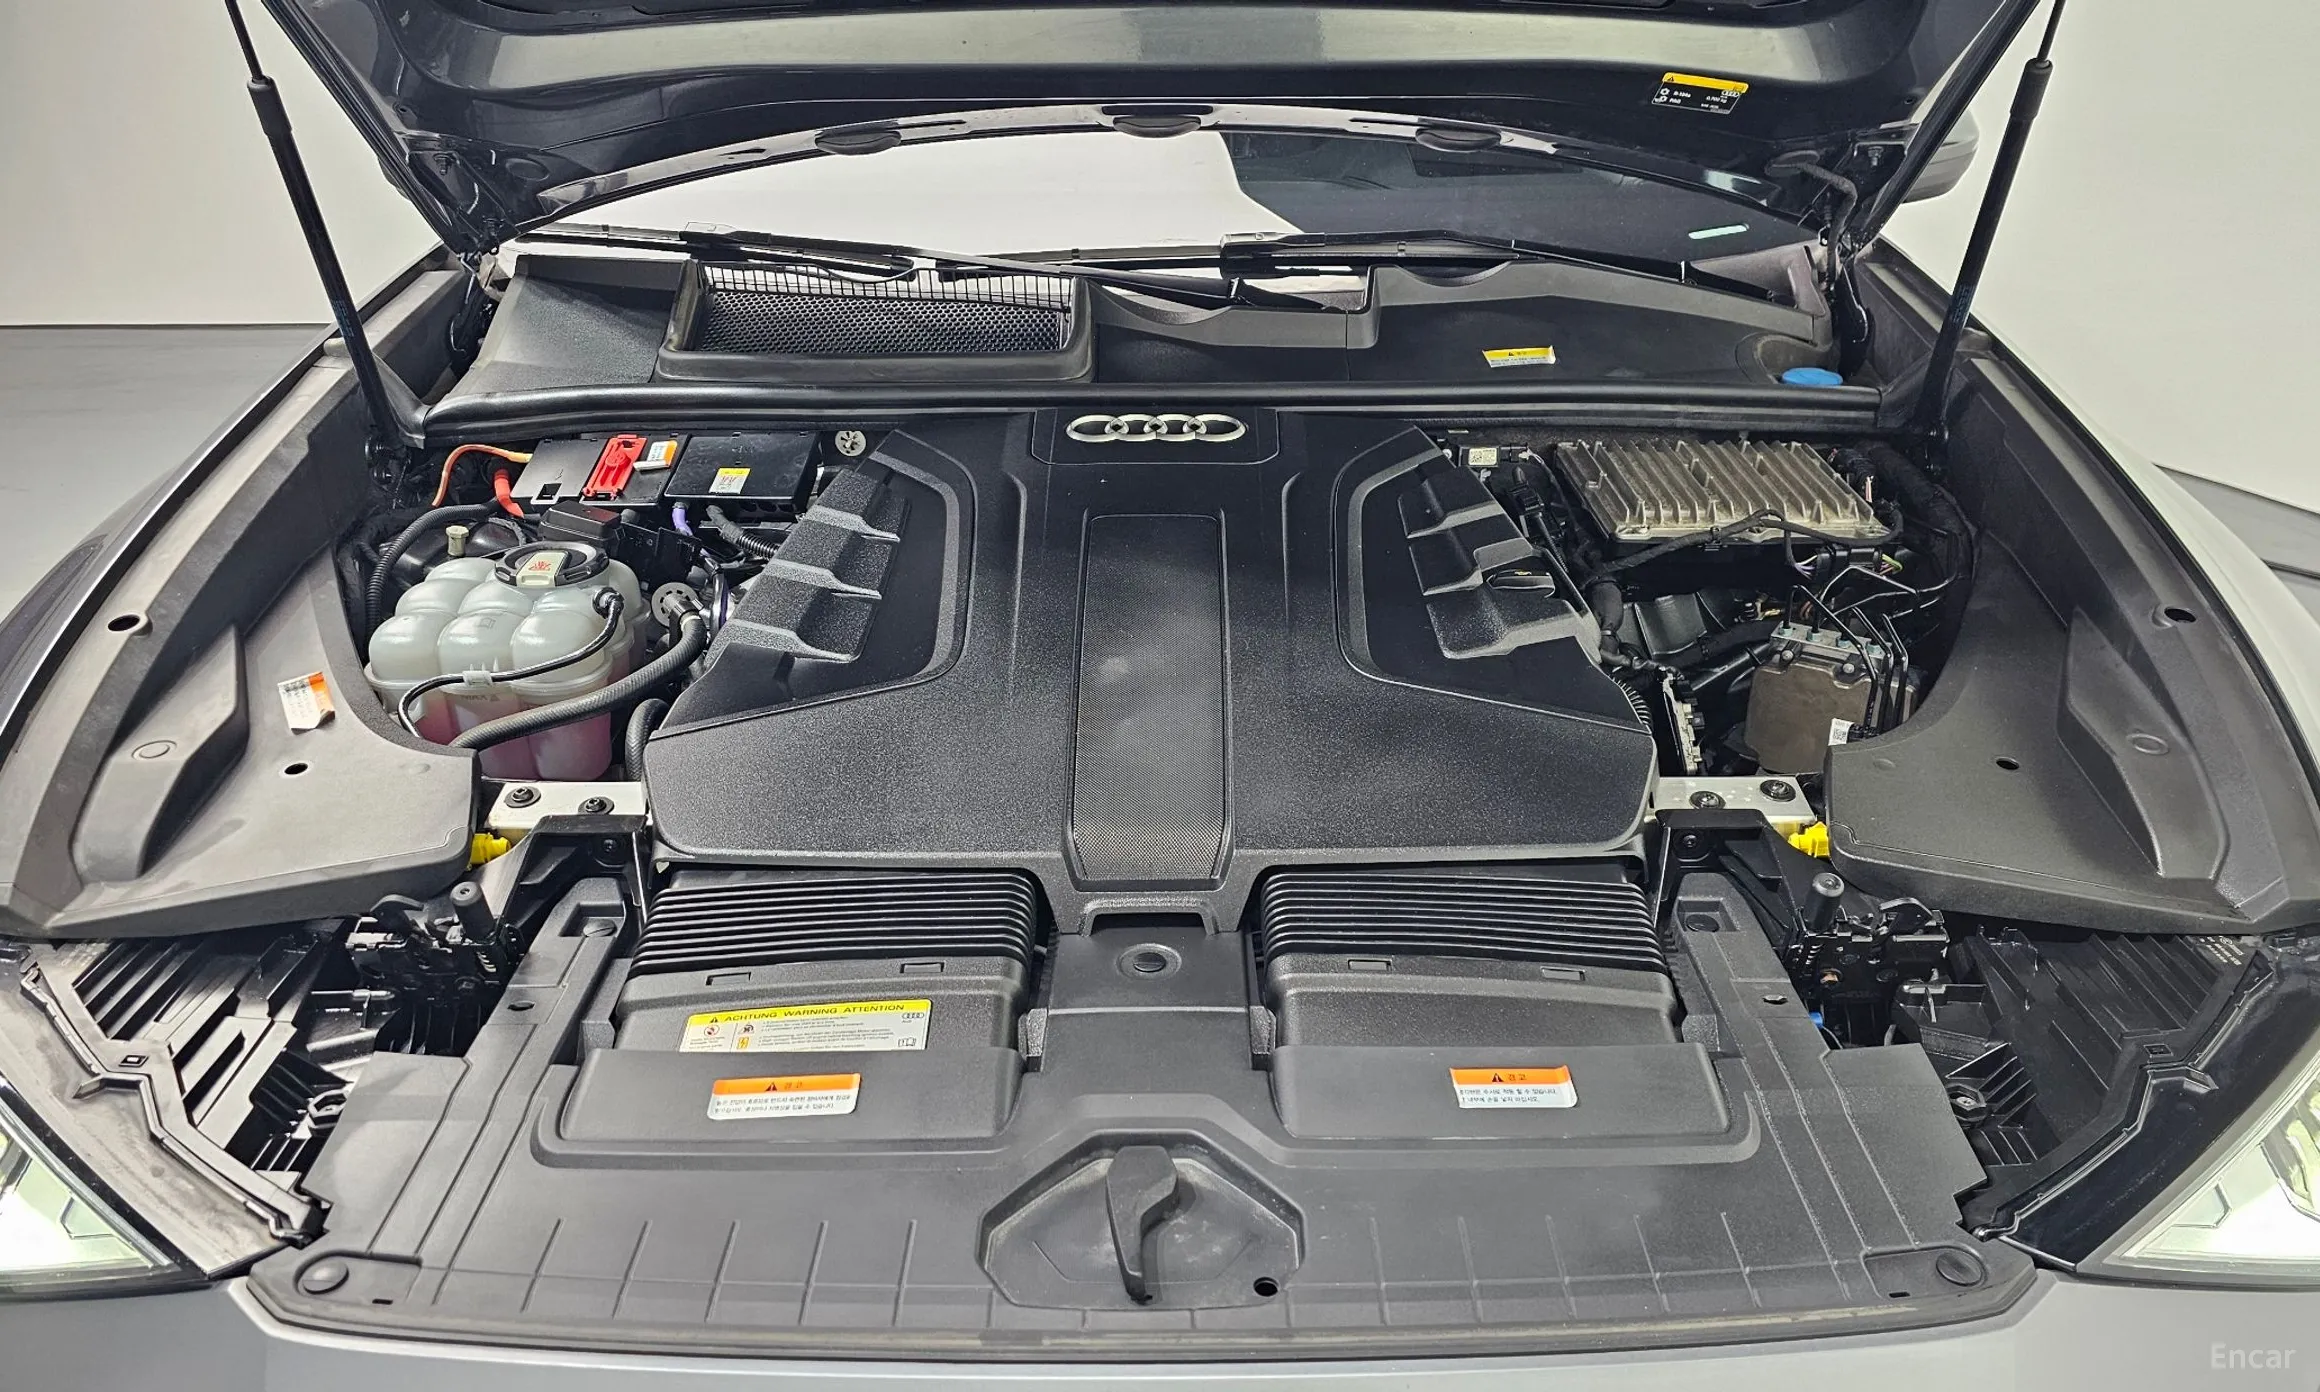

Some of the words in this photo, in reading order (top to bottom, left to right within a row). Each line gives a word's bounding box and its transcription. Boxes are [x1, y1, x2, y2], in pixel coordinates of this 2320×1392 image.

[724, 1012, 778, 1022] ACHTUNG
[784, 1007, 838, 1017] WARNING
[843, 1004, 905, 1014] ATTENTION
